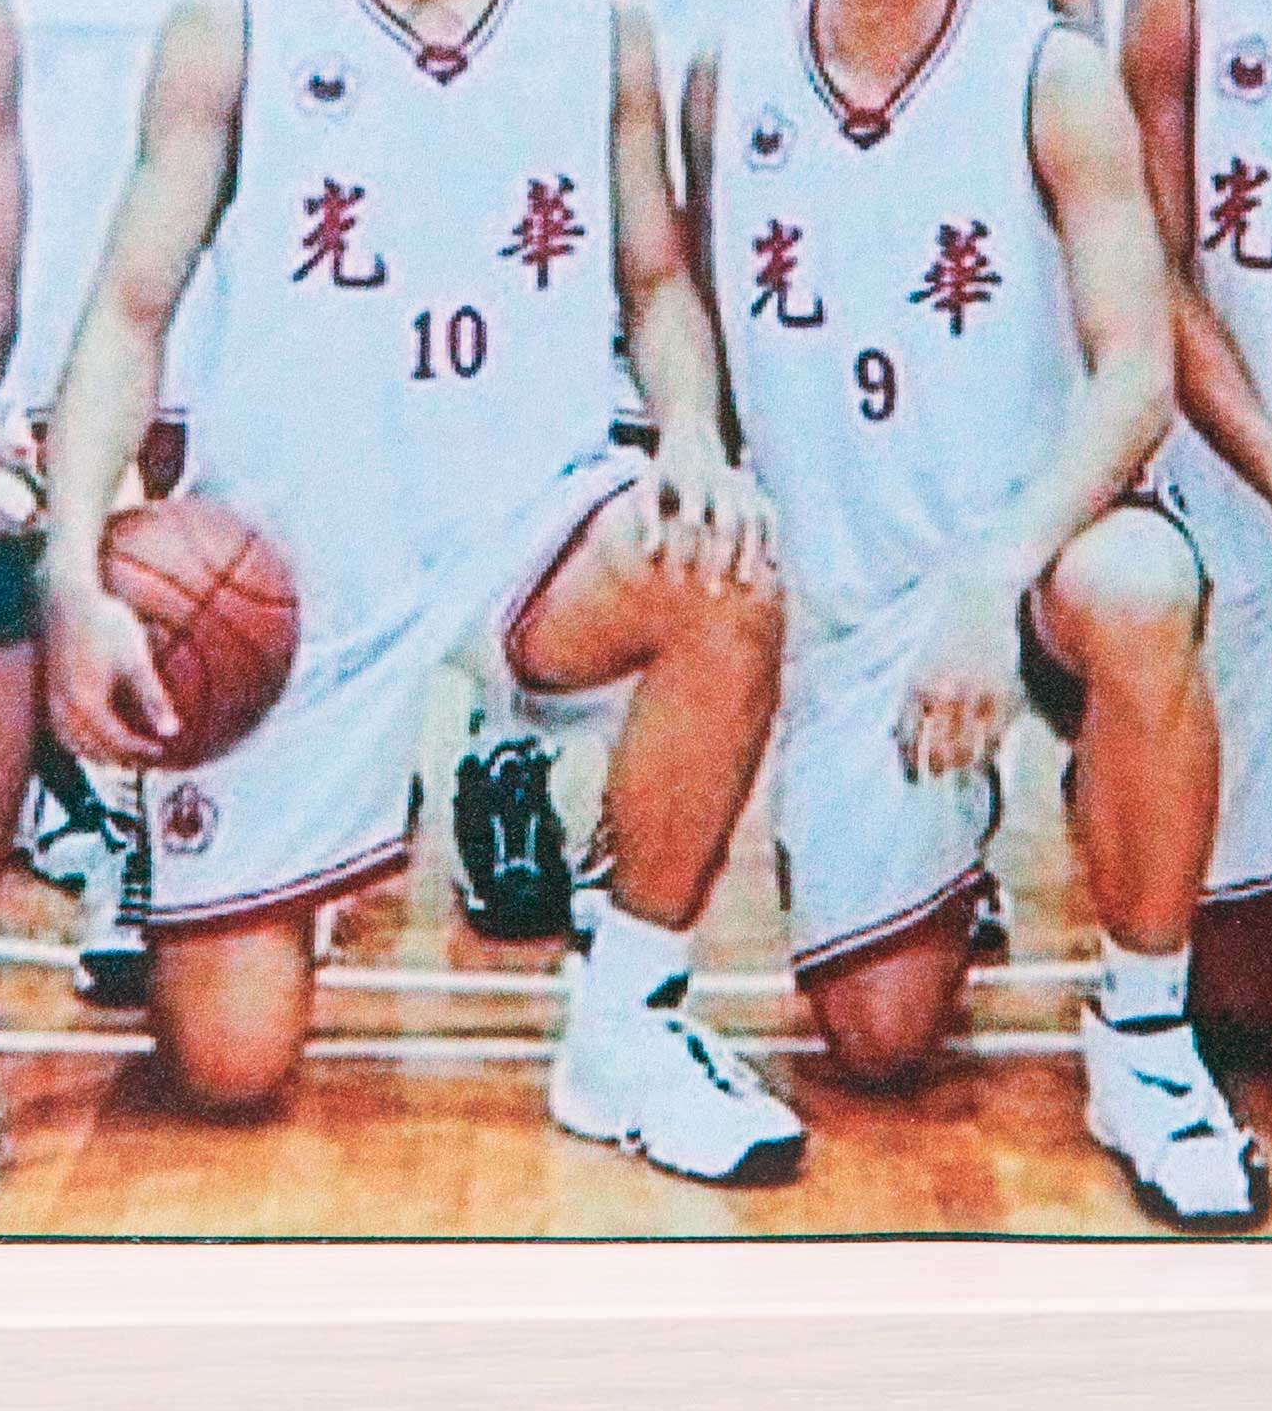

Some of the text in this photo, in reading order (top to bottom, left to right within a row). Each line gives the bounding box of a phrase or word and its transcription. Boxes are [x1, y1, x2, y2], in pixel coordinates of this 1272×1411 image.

[292, 173, 587, 291] 光 華
[750, 218, 1003, 338] 光 華
[411, 304, 488, 381] 10
[853, 347, 898, 423] 9
